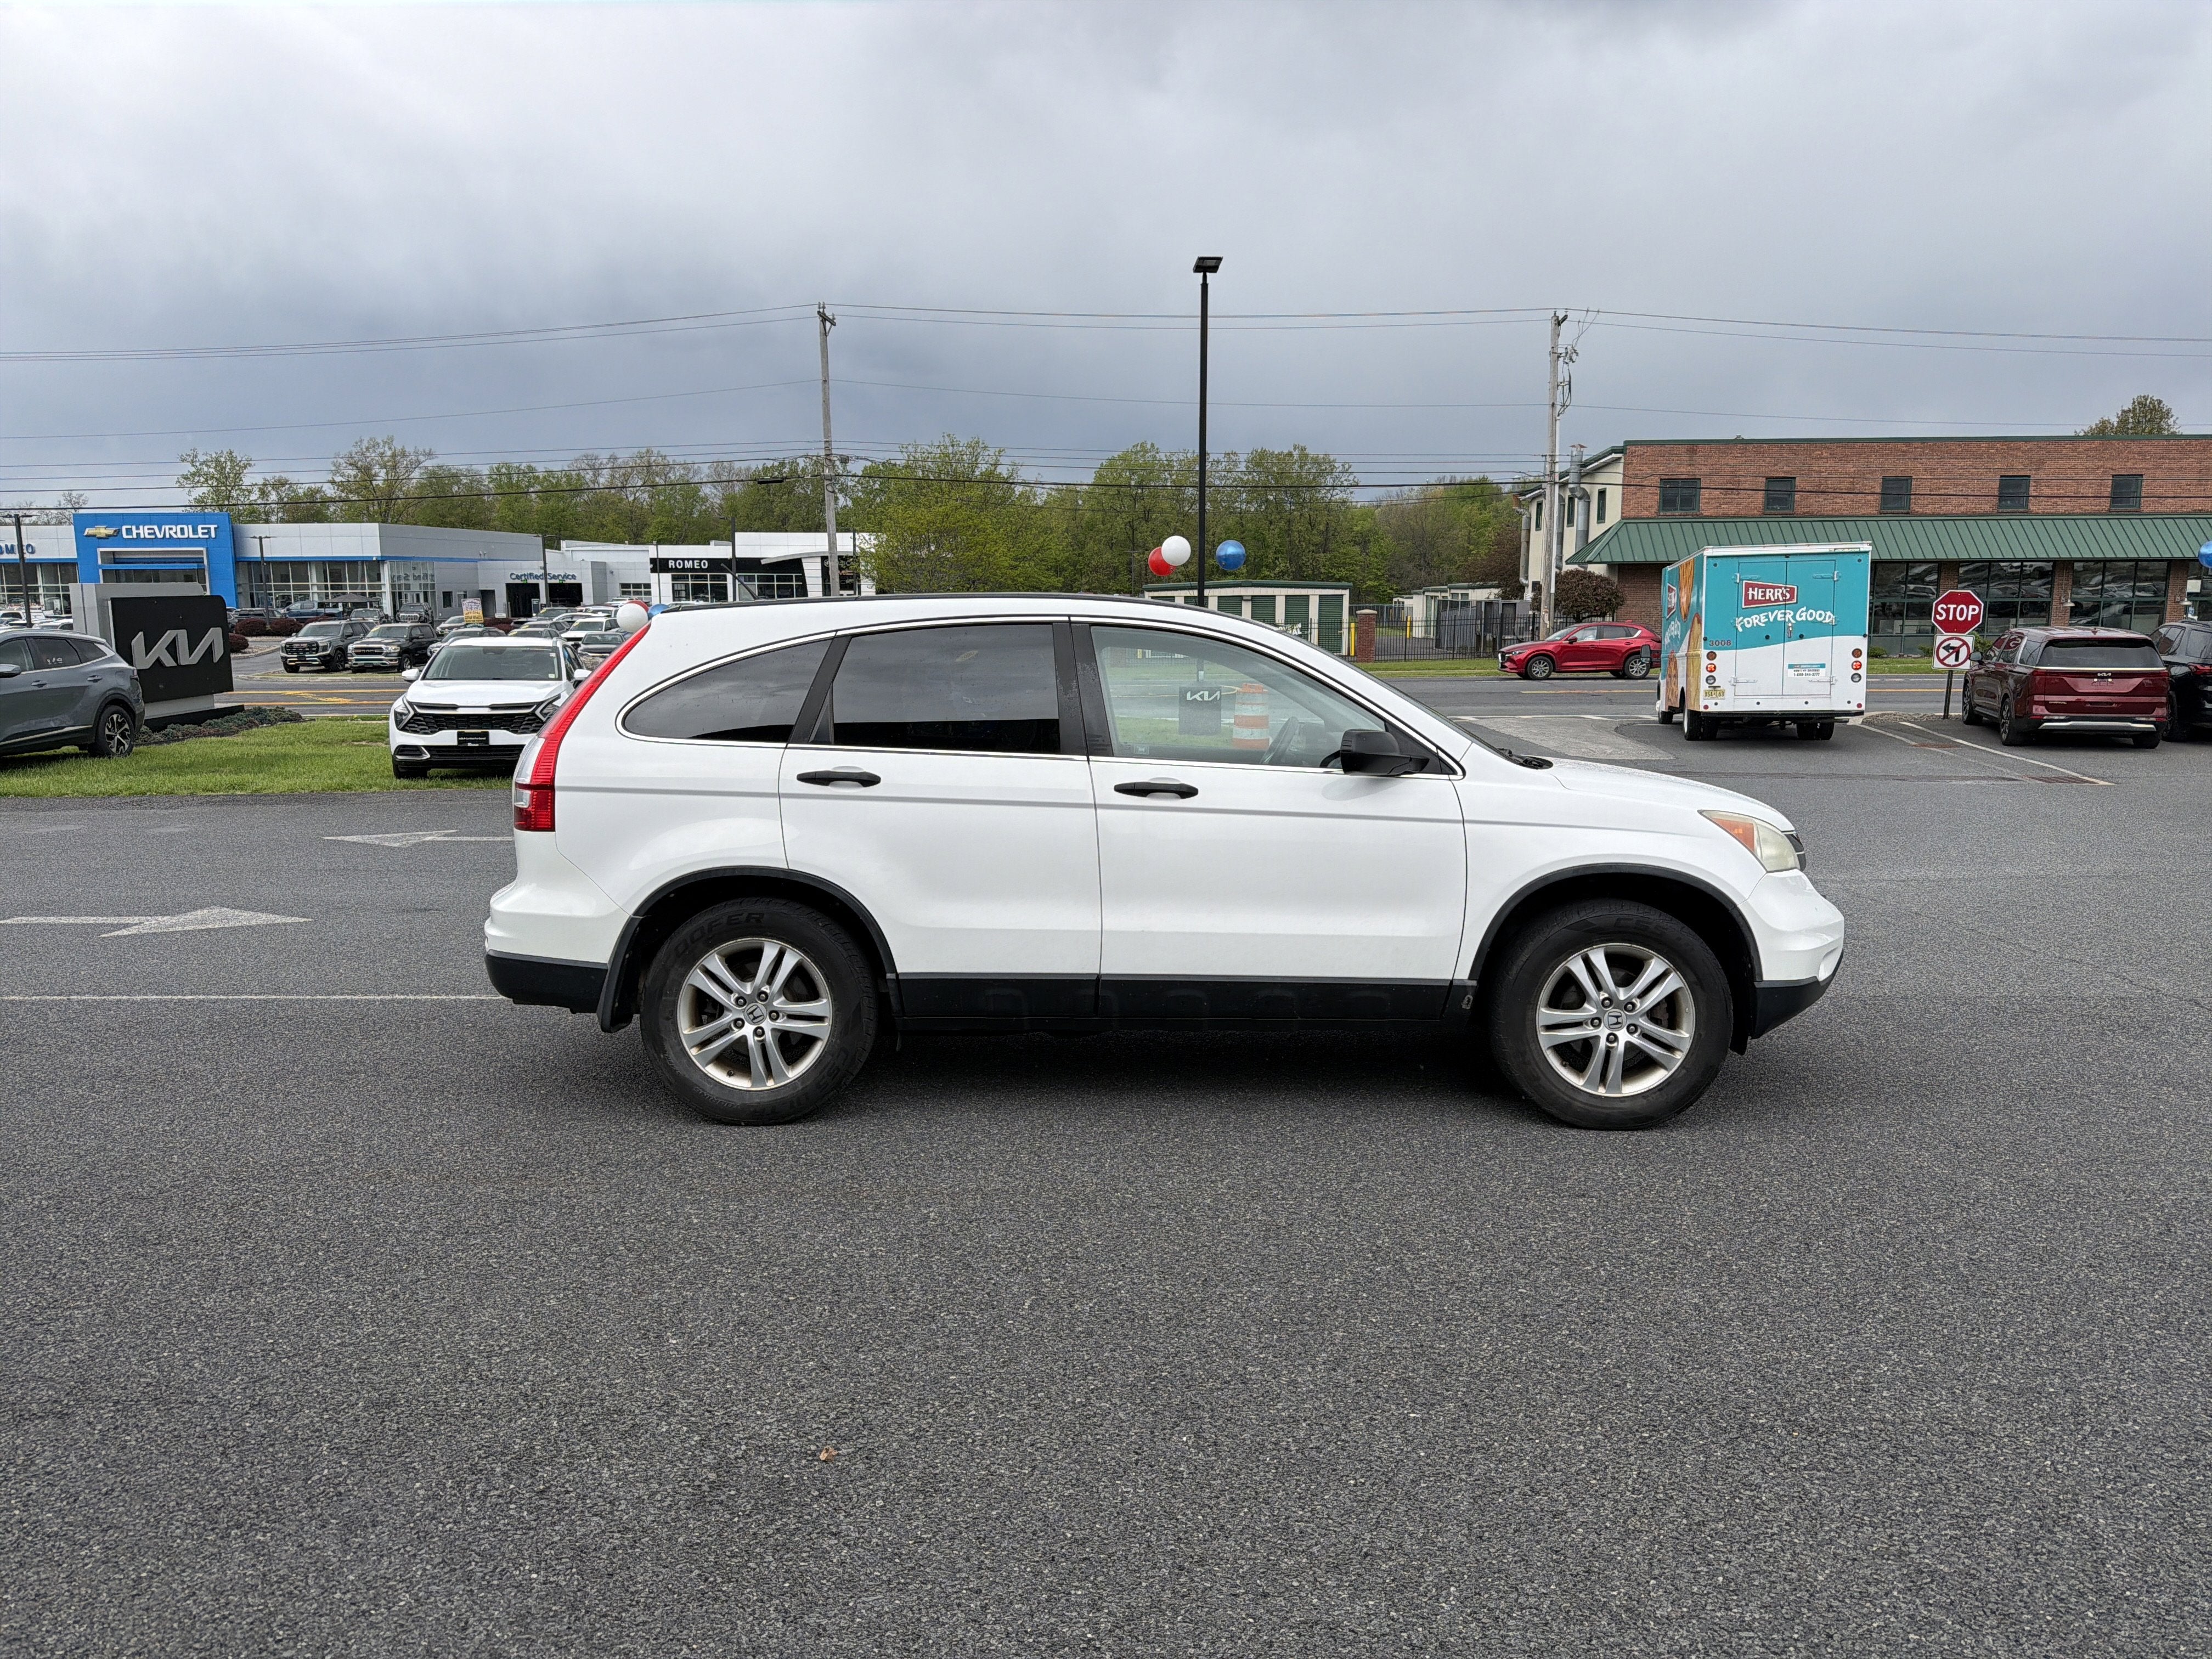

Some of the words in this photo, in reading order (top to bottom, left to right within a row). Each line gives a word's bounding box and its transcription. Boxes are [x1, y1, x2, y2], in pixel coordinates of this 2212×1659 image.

[122, 524, 218, 539] CHEVROLET
[668, 560, 708, 569] ROMEO
[510, 572, 544, 580] Certified
[547, 572, 577, 580] Service
[1747, 588, 1791, 601] HERR'S
[1736, 610, 1796, 632] FOREVER
[1796, 606, 1834, 623] GOOD
[1936, 604, 1979, 621] STOP
[132, 627, 224, 670] KIA
[1186, 691, 1220, 701] KIA
